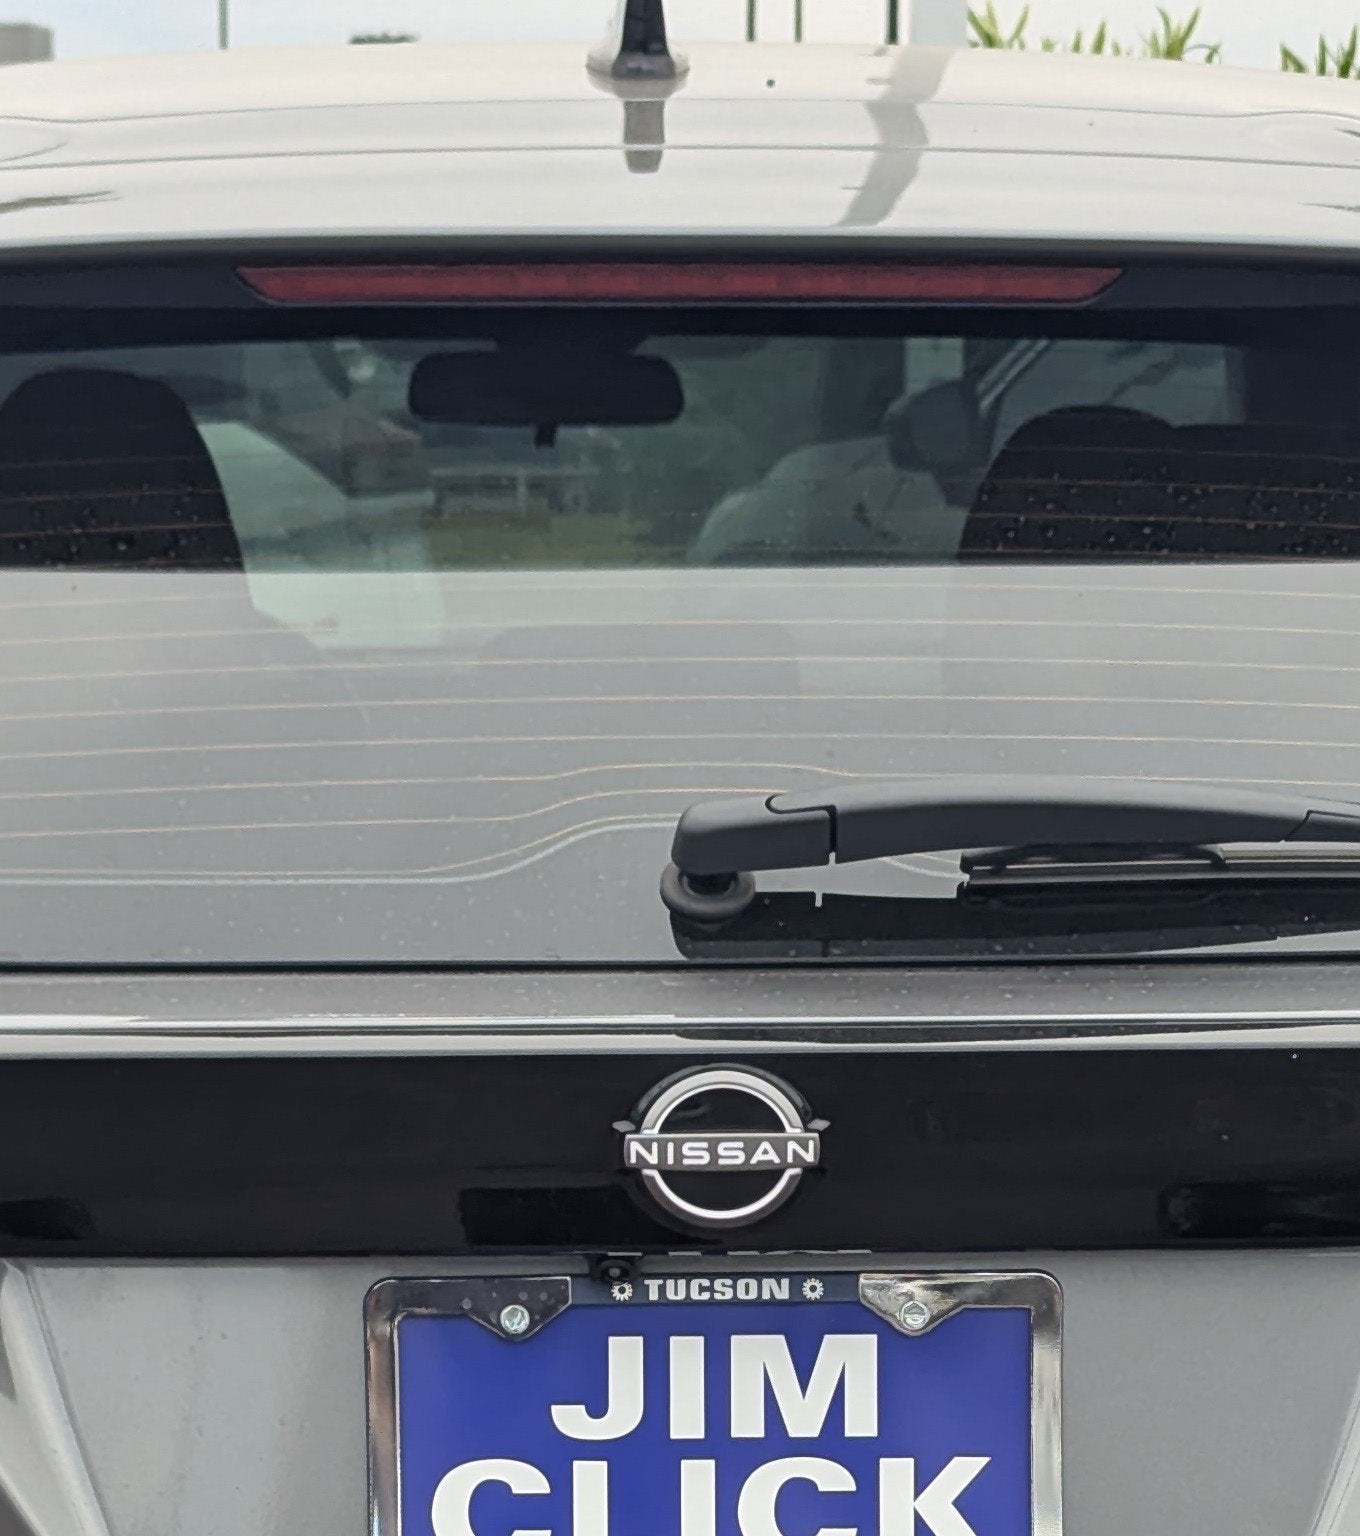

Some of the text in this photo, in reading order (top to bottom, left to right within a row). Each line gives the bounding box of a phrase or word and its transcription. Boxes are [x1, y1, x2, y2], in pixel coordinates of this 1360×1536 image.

[629, 1139, 816, 1166] NISSAN
[643, 1277, 791, 1301] TUCSON
[550, 1333, 879, 1441] JIM
